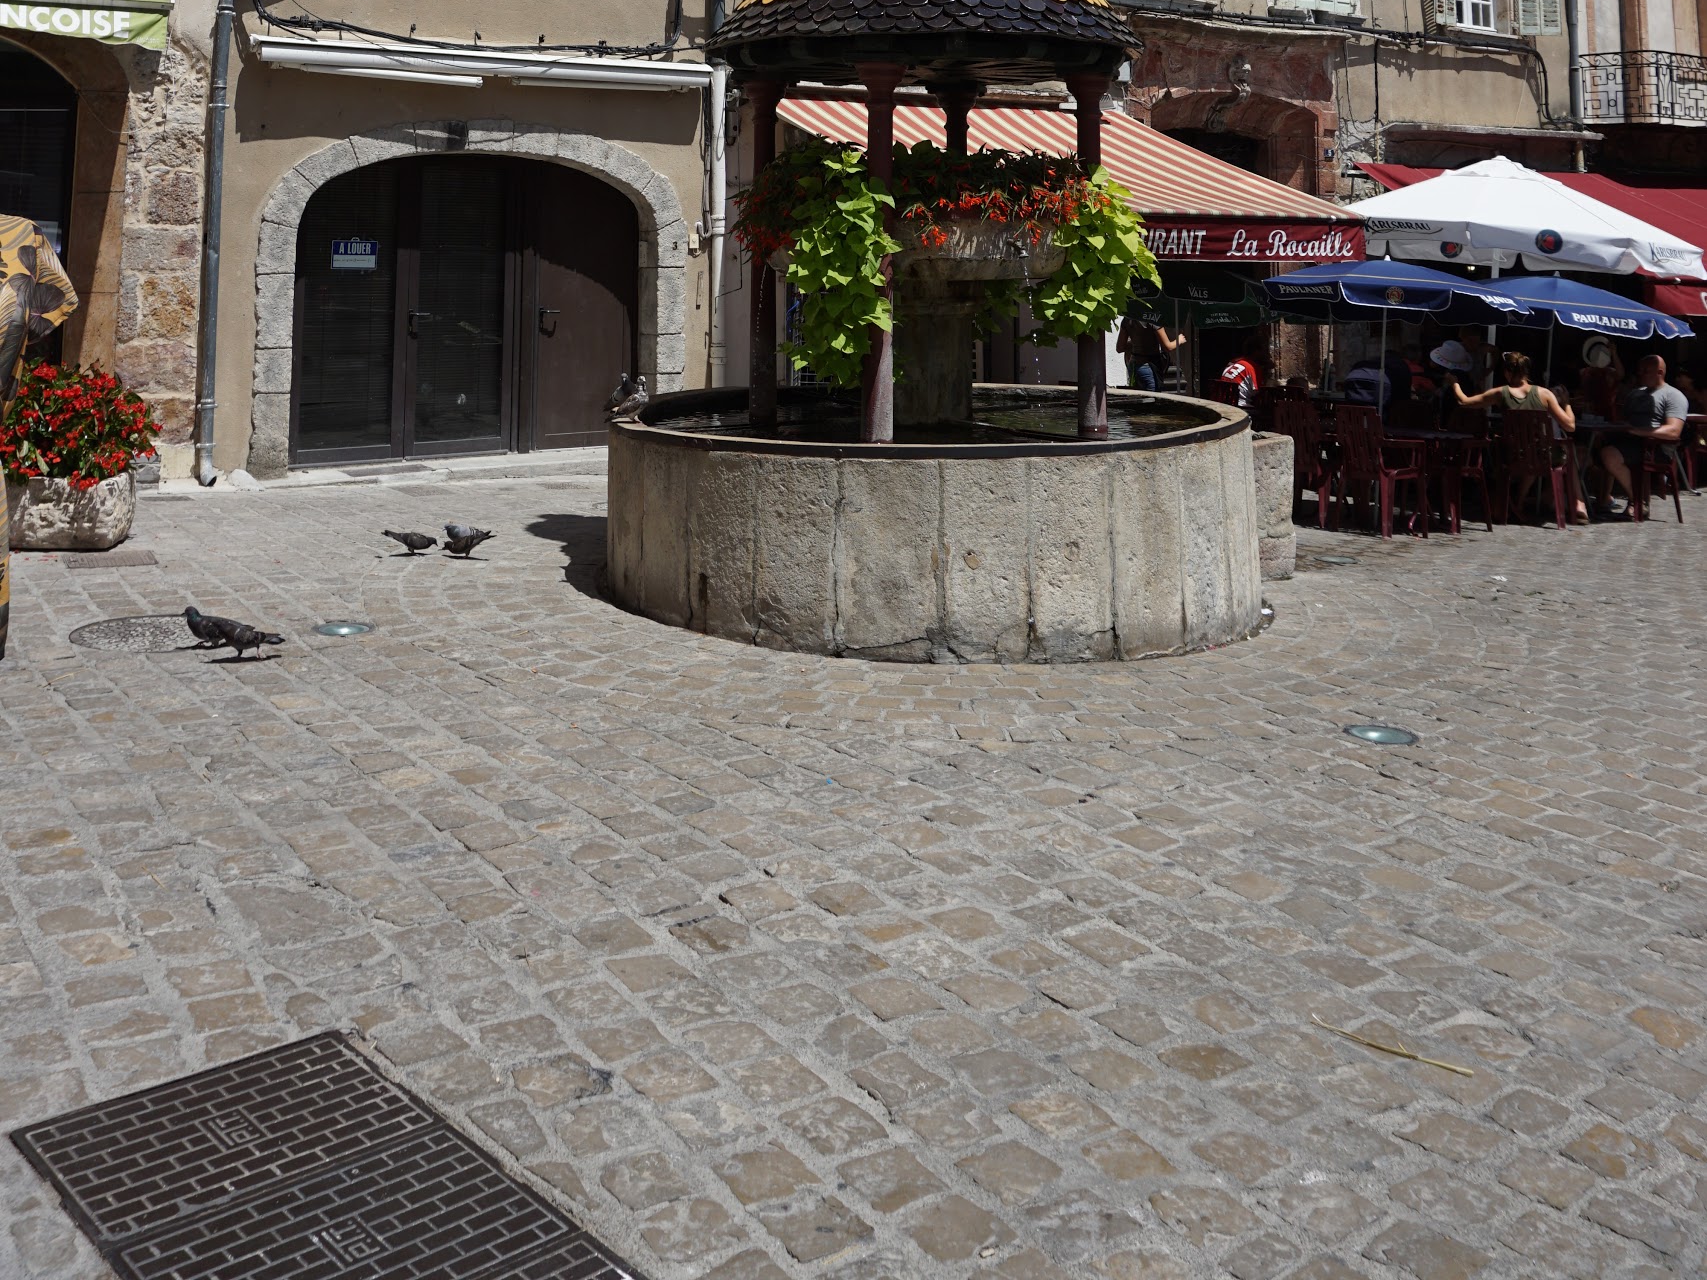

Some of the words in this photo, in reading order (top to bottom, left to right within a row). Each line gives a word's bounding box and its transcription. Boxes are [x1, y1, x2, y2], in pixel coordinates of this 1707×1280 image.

[339, 242, 344, 254] A
[347, 242, 372, 255] LOUER
[672, 241, 678, 251] 3
[1226, 228, 1259, 257] La
[1266, 229, 1354, 257] Rocaille
[1278, 284, 1334, 295] PAULANER
[1571, 312, 1639, 330] PAULANER
